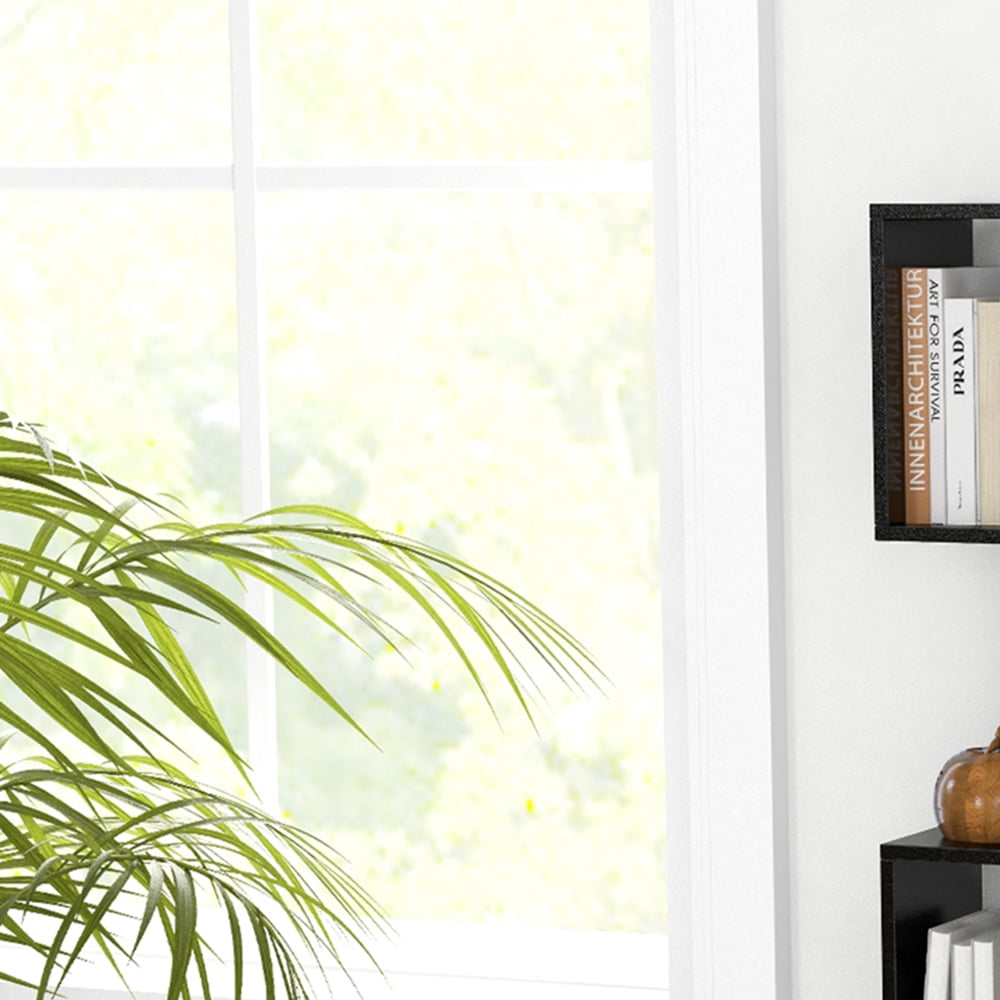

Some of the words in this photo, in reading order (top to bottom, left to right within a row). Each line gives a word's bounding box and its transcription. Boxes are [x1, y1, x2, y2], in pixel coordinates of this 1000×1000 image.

[929, 279, 939, 308] ART
[929, 314, 940, 346] FOR
[953, 326, 965, 395] PRADA
[906, 268, 925, 491] INNENARCHITEKTUR
[930, 352, 941, 422] SURVIVAL
